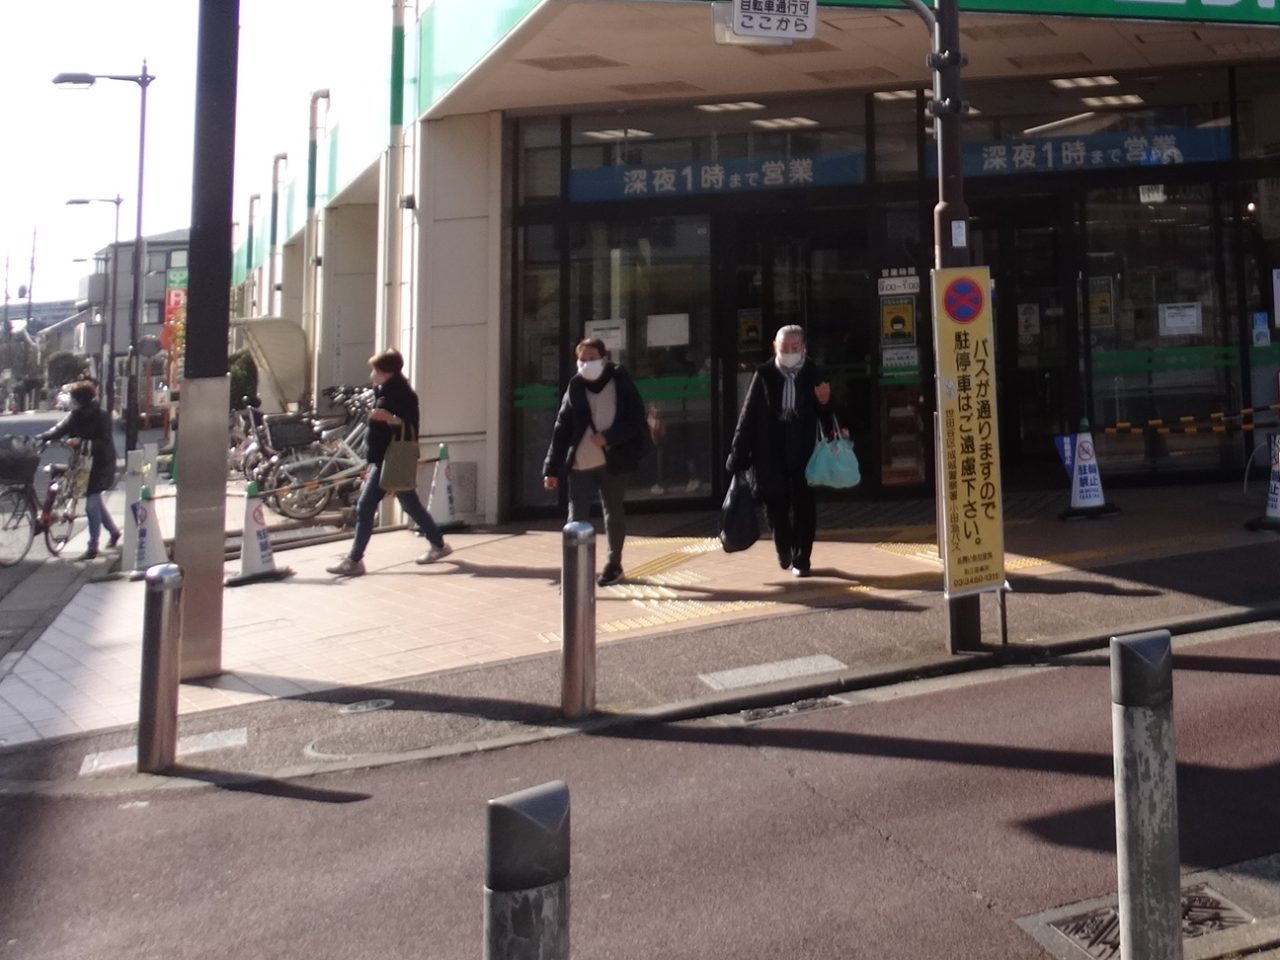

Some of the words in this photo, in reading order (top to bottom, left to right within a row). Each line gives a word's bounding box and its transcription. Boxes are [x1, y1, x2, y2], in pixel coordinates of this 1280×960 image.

[740, 14, 808, 32] ここから
[623, 157, 814, 195] 深夜1時まで営業
[954, 330, 982, 545] 駐停車はご遠慮下さい。
[973, 338, 997, 520] バスが通りますので
